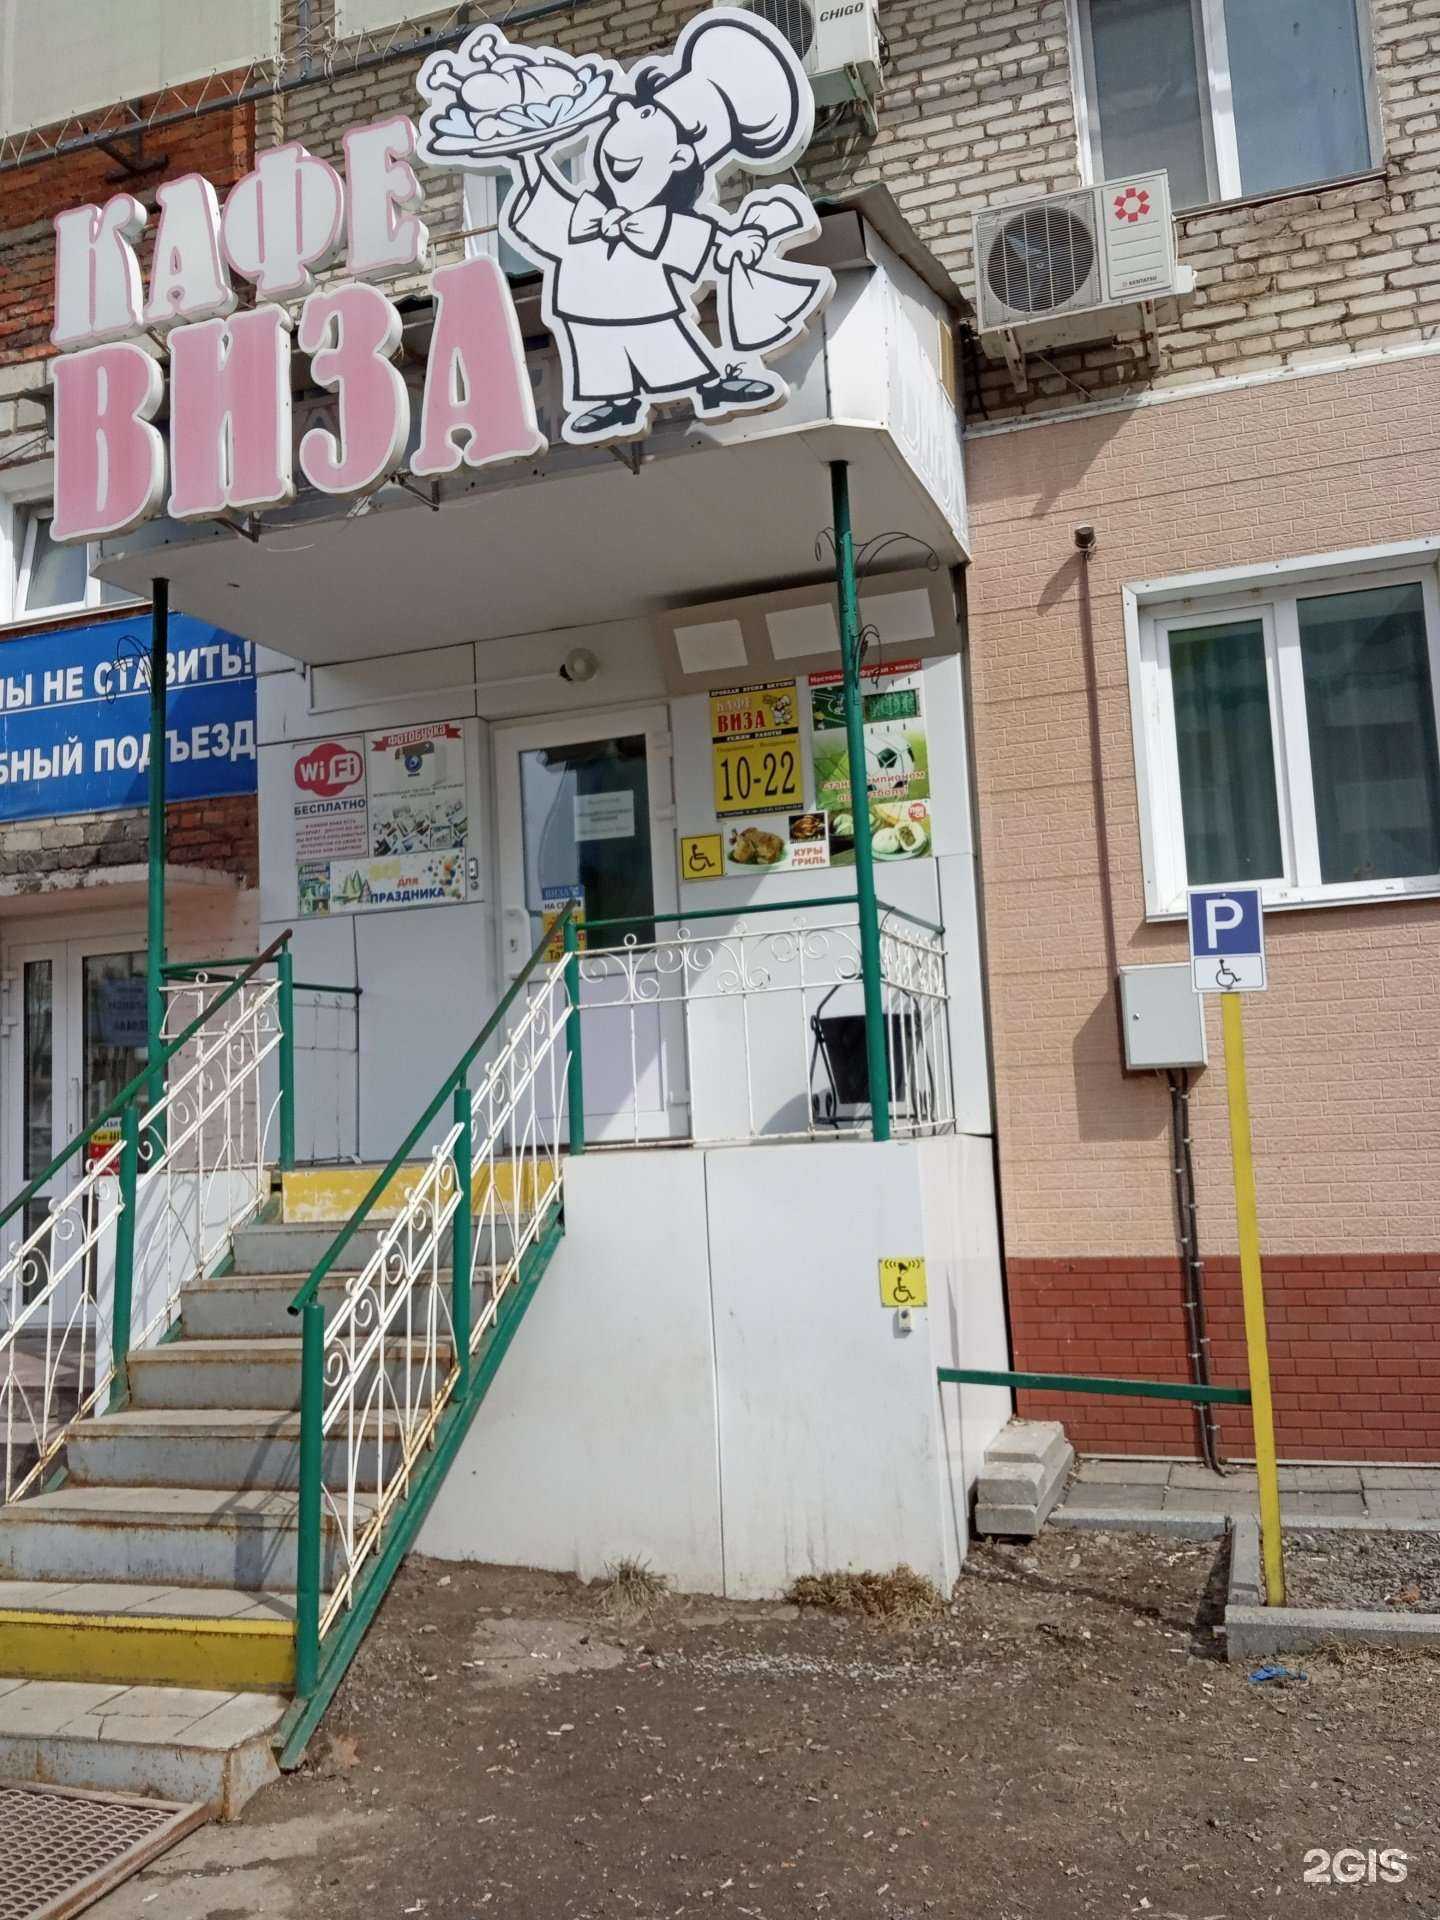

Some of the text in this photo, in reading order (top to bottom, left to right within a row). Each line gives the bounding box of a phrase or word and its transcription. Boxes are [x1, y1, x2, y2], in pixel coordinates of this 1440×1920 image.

[820, 2, 864, 22] CHIGO
[50, 115, 428, 350] КАФЕ
[50, 255, 549, 542] ВИЗА
[43, 665, 84, 704] НЕ
[93, 640, 253, 695] СТАВИТЬ!
[717, 709, 766, 734] ВИЗА
[721, 751, 795, 800] 10-22
[294, 799, 366, 816] БЕСПЛАТНО
[792, 857, 826, 867] ГРИЛЬ
[794, 847, 823, 857] КУРЫ
[371, 887, 446, 904] ПРАЗДНИКА
[1205, 899, 1244, 949] P
